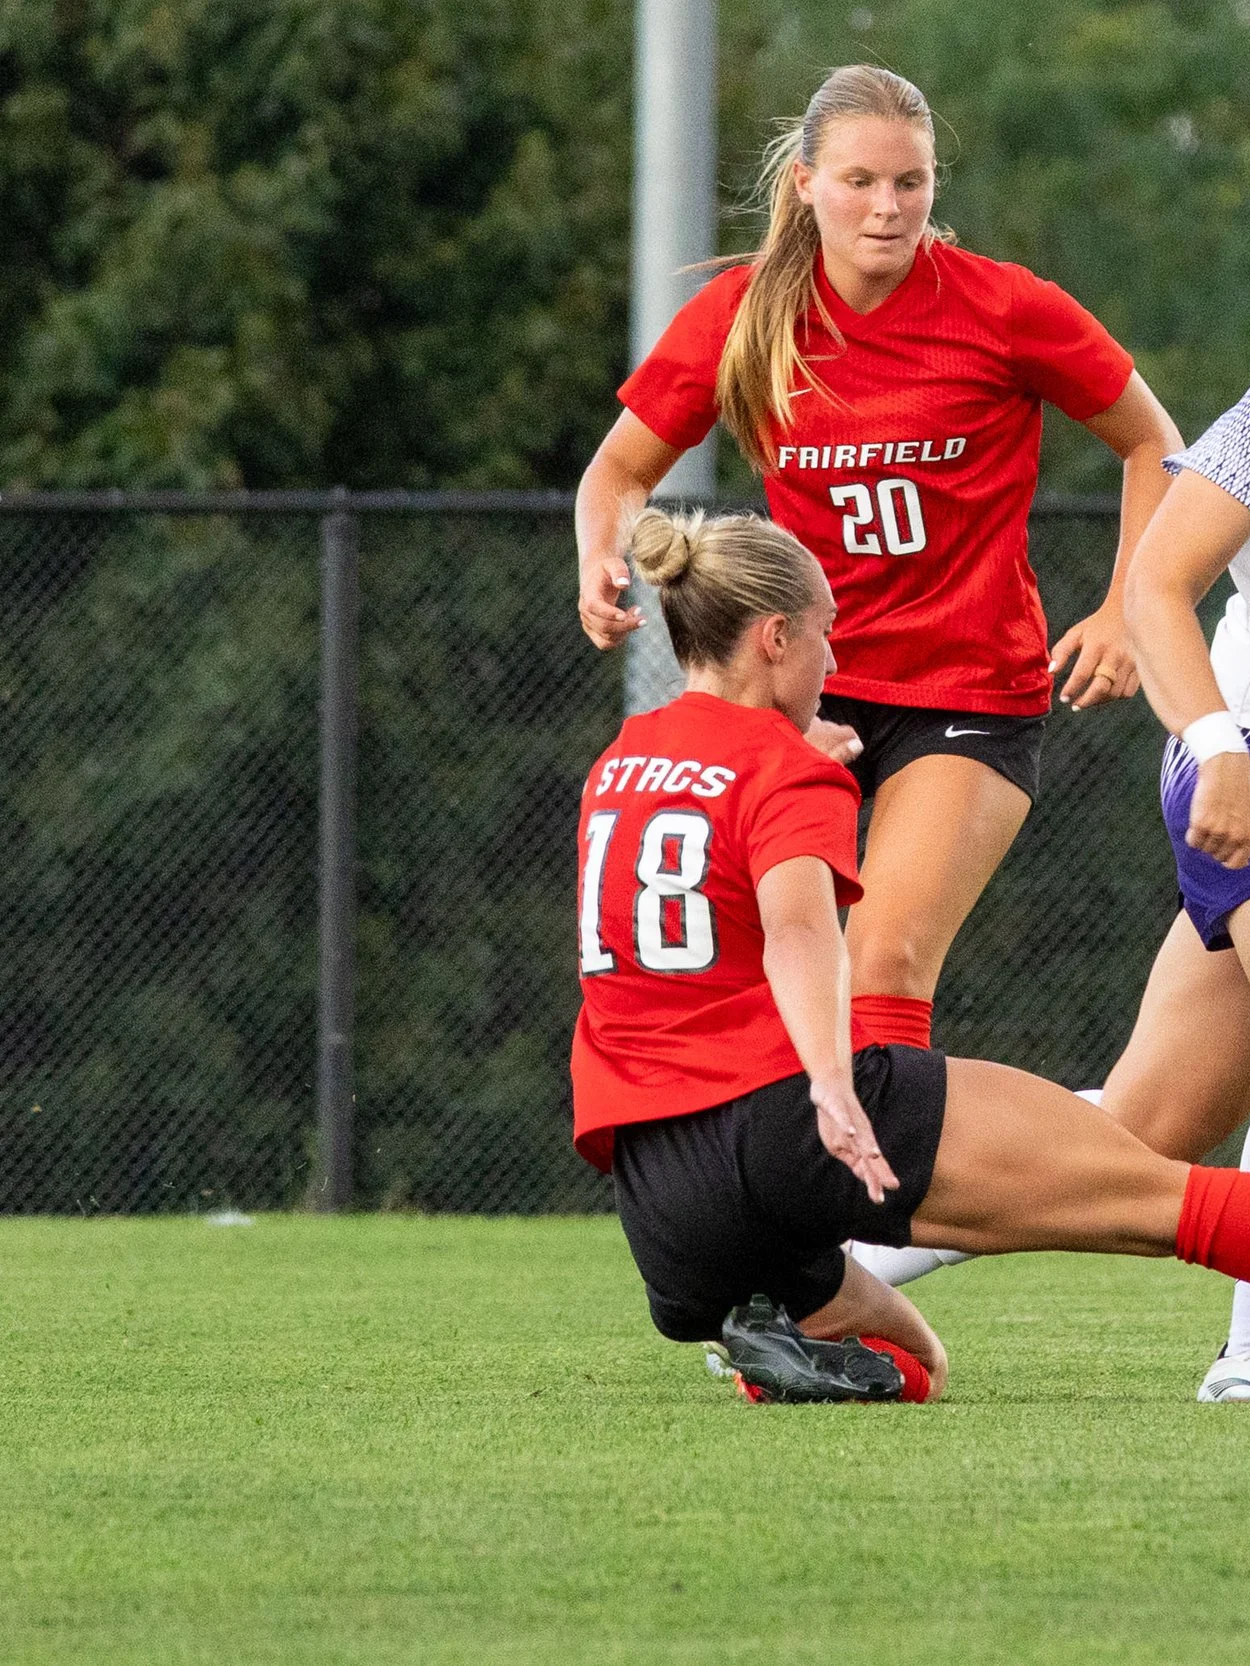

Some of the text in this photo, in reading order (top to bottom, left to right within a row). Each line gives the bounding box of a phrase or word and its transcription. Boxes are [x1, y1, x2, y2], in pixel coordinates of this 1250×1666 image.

[779, 437, 966, 469] FAIRFIELD
[829, 478, 926, 556] 20
[580, 809, 720, 976] 18
